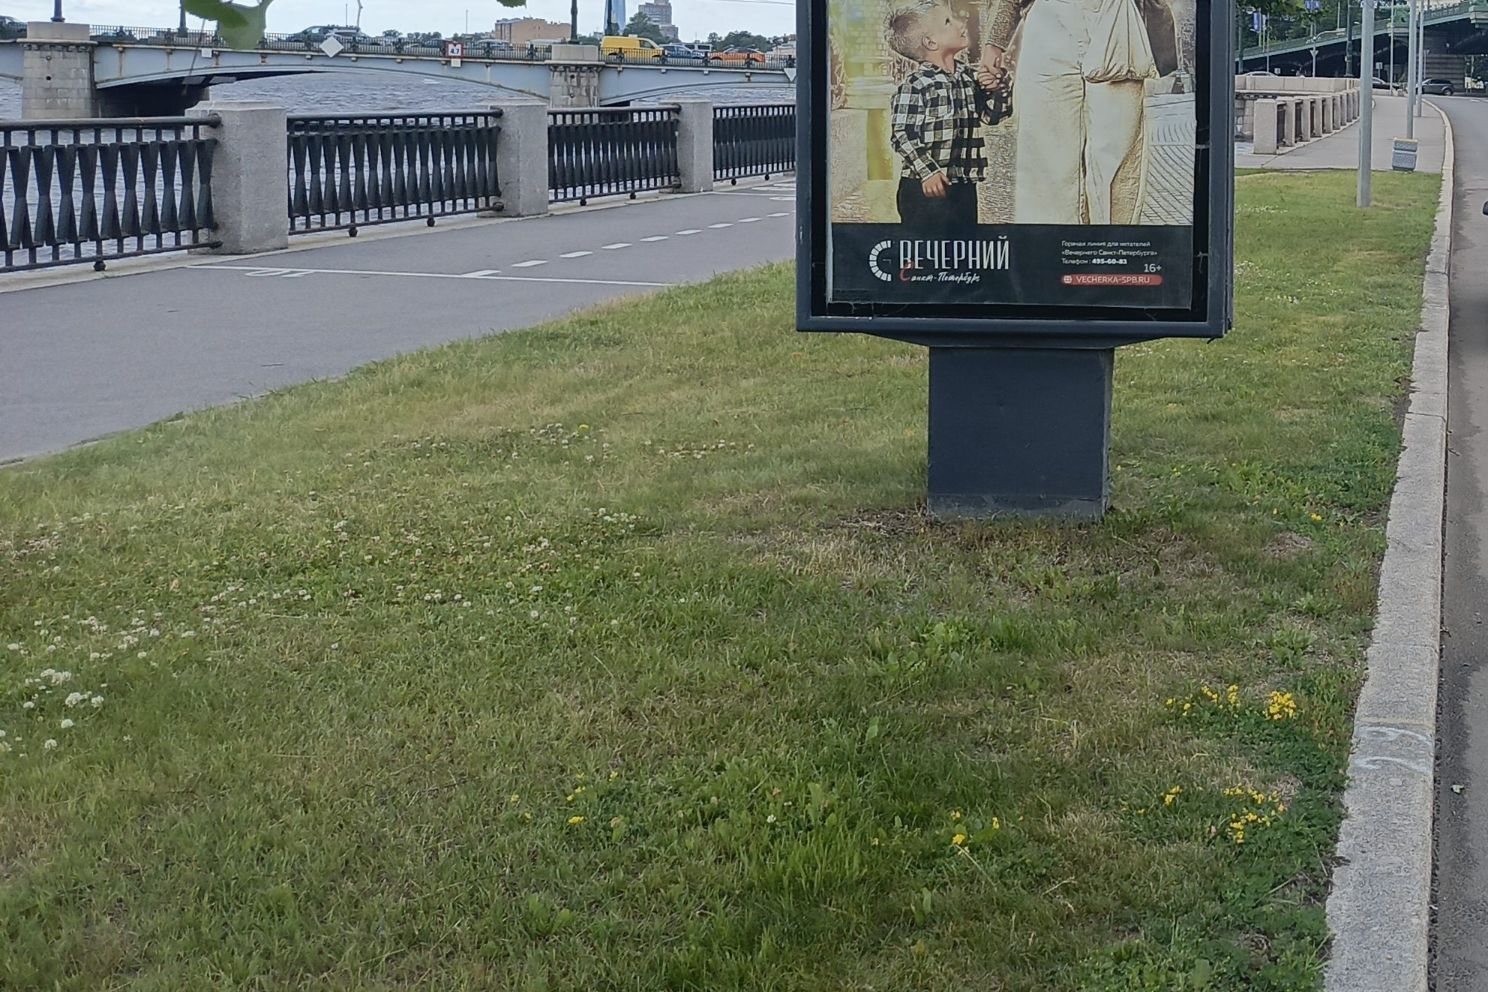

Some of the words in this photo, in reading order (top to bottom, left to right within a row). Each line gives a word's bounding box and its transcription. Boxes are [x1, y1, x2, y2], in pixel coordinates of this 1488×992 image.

[899, 235, 1009, 270] ВЕЧЕРНИЙ
[1143, 263, 1162, 273] 16+
[1075, 275, 1150, 284] VECHERKA-SPB.RU
